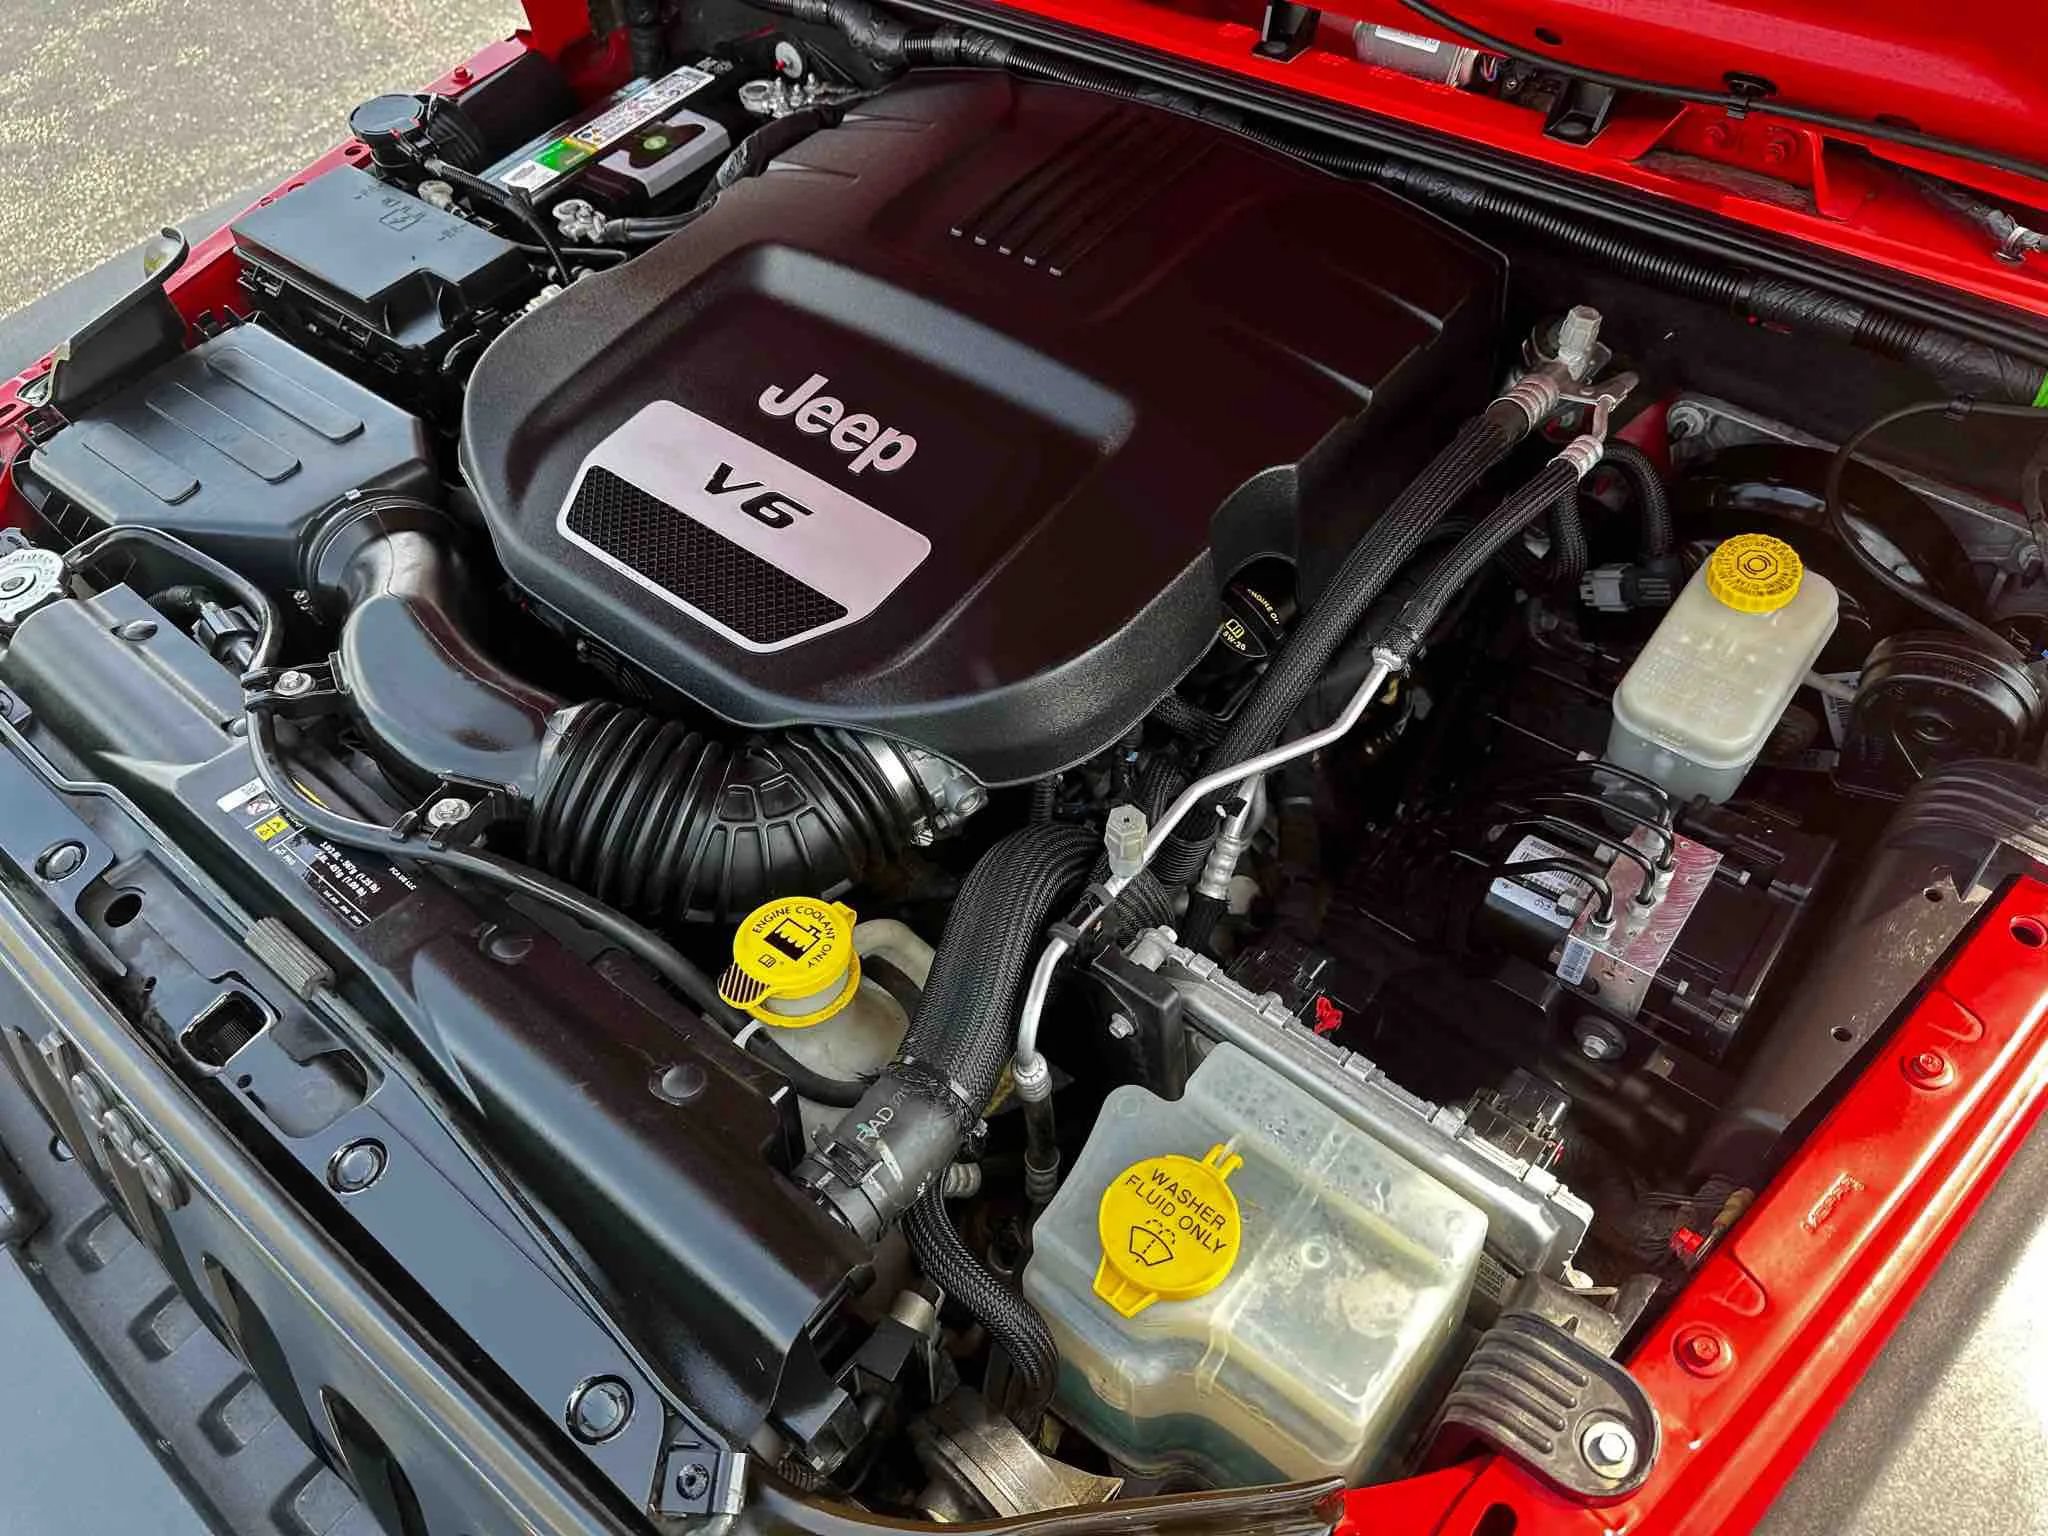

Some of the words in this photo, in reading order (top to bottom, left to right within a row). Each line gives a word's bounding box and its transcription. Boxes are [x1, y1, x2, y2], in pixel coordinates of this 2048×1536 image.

[758, 373, 918, 474] Jeep
[704, 462, 815, 529] V6
[751, 906, 792, 934] ENGINE
[795, 905, 837, 940] COOLANT
[806, 943, 832, 968] ONLY
[1125, 1174, 1176, 1217] FLUID
[1178, 1215, 1227, 1254] ONLY
[1151, 1167, 1226, 1231] WASHER
